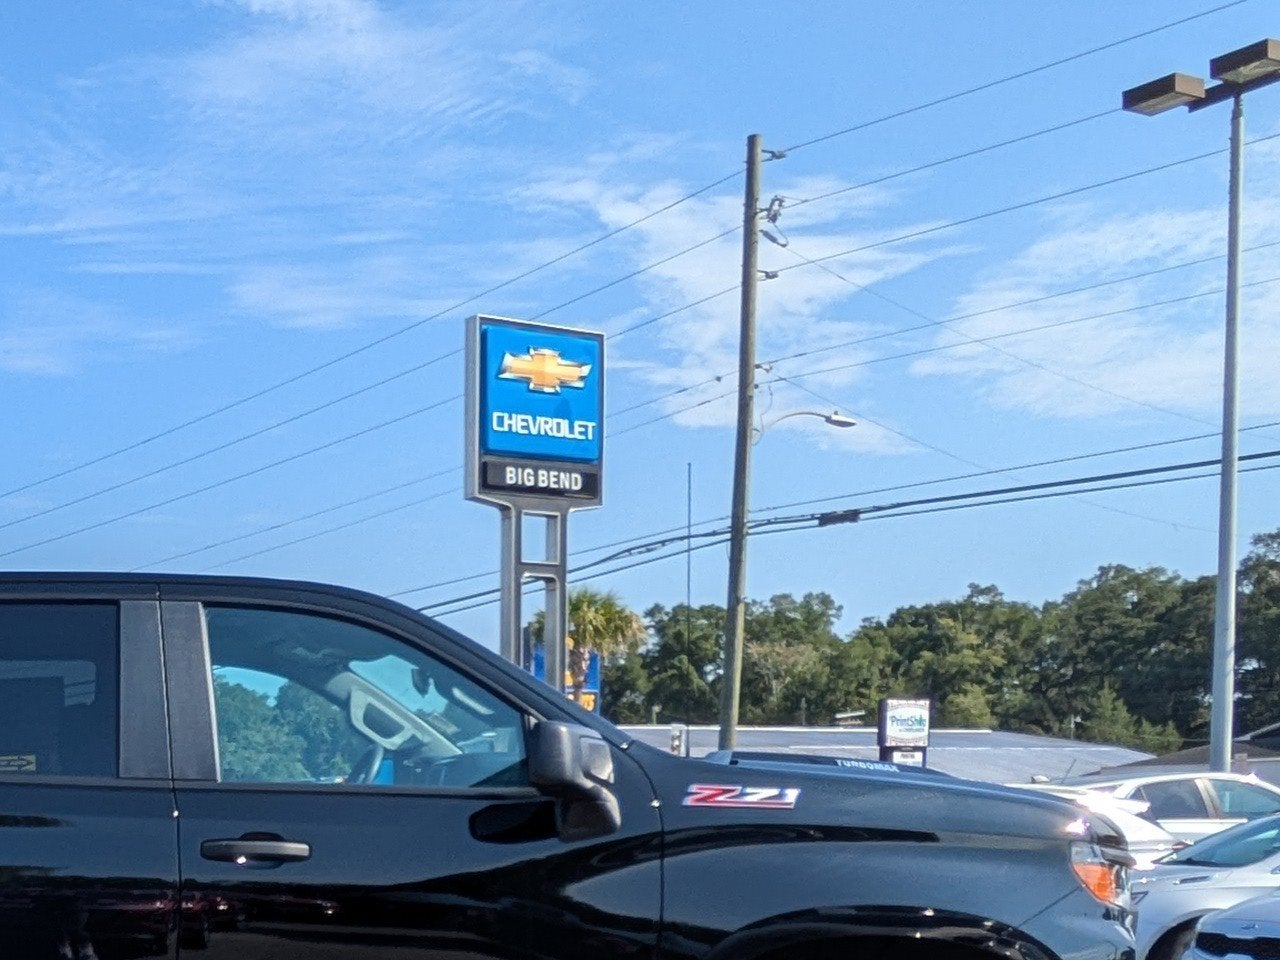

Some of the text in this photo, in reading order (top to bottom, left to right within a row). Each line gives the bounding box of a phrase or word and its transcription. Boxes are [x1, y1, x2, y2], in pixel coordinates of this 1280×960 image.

[491, 411, 597, 440] CHEVROLET
[505, 466, 583, 490] BIG BEND
[835, 759, 900, 773] TURBOMAX
[682, 783, 801, 809] Z71
